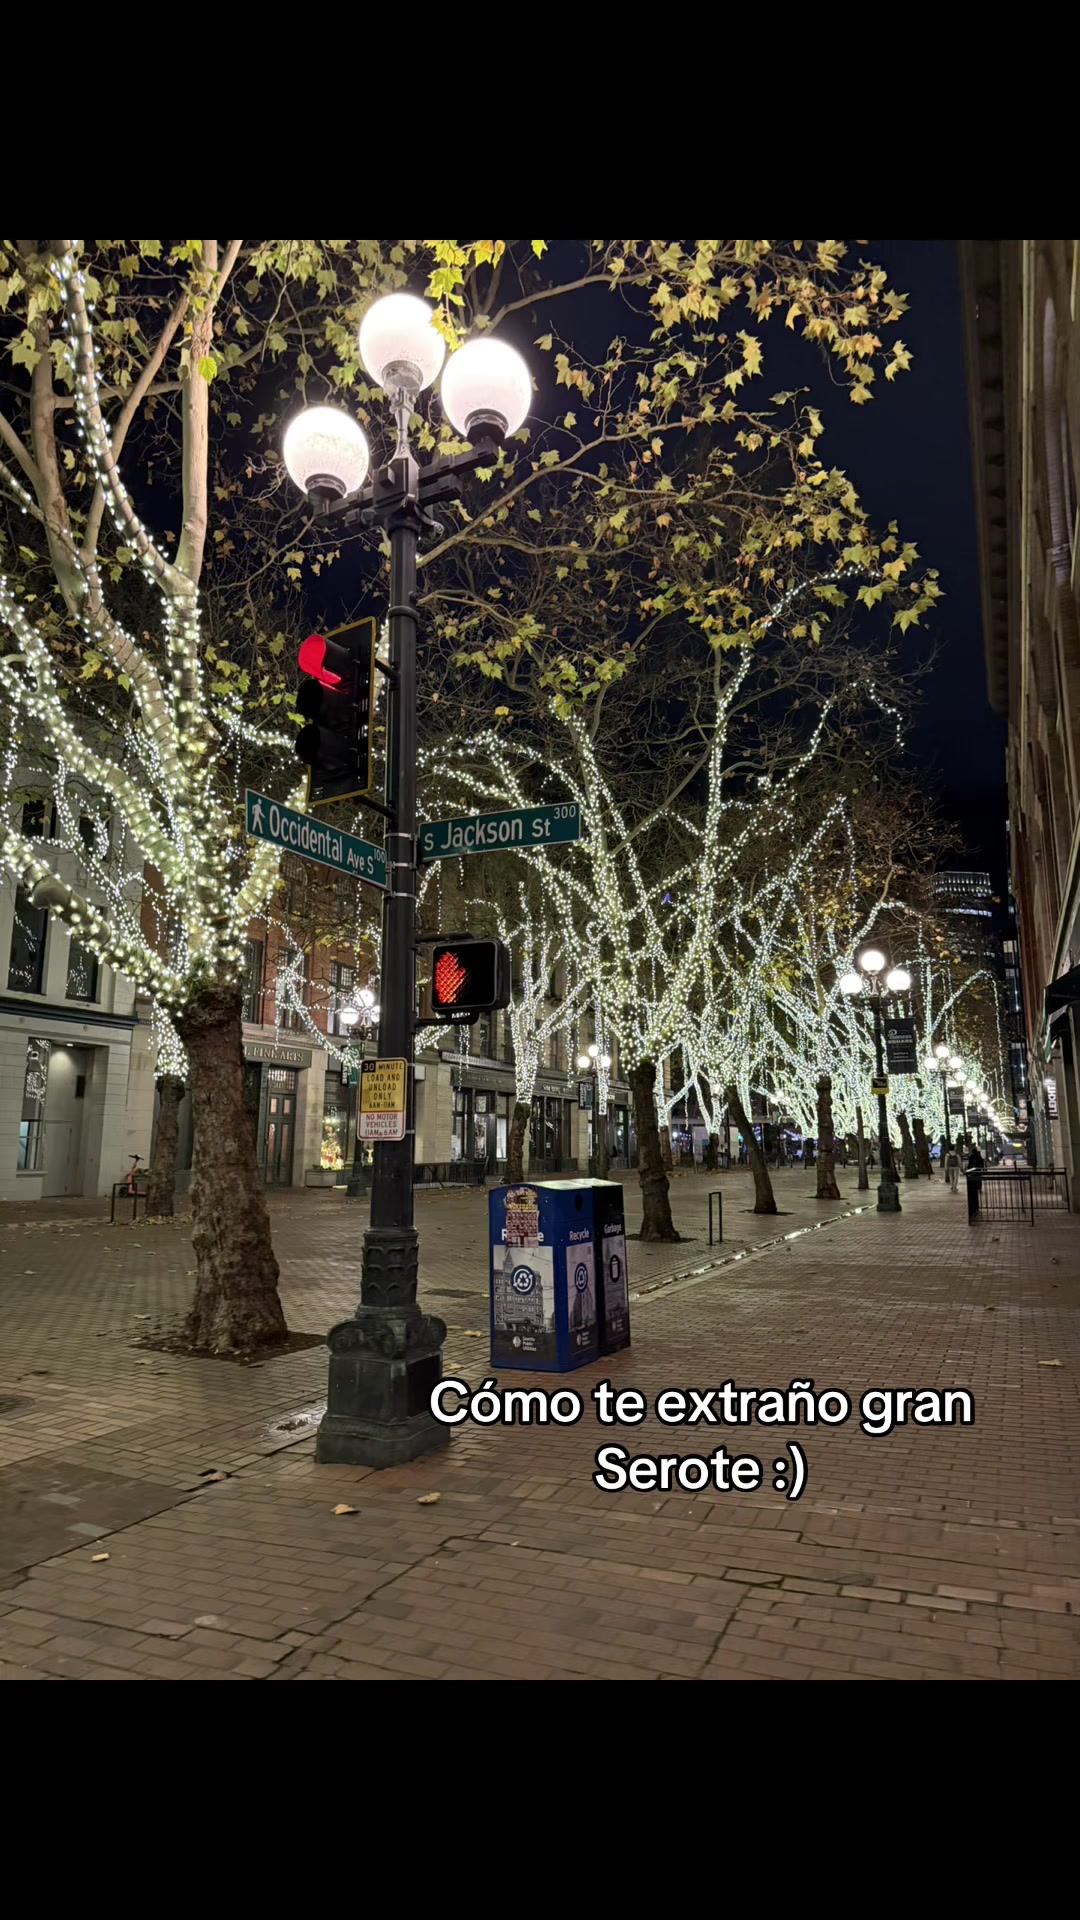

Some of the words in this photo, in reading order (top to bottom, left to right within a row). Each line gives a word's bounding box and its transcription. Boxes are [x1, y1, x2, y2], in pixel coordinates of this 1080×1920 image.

[423, 833, 434, 850] S
[440, 818, 523, 850] Jackson
[532, 819, 551, 838] St
[554, 805, 576, 819] 300
[268, 805, 343, 863] Occidental
[347, 849, 365, 869] Ave
[367, 858, 375, 875] S
[374, 848, 386, 863] 100
[253, 1047, 278, 1058] FINE
[280, 1051, 304, 1062] ARTS
[363, 1063, 375, 1071] 30
[378, 1062, 403, 1070] MINUTE
[387, 1073, 400, 1081] AND
[368, 1083, 396, 1091] UNLOAD
[373, 1092, 392, 1100] ONLY
[569, 1228, 589, 1242] Recycle
[604, 1223, 622, 1235] Garbage
